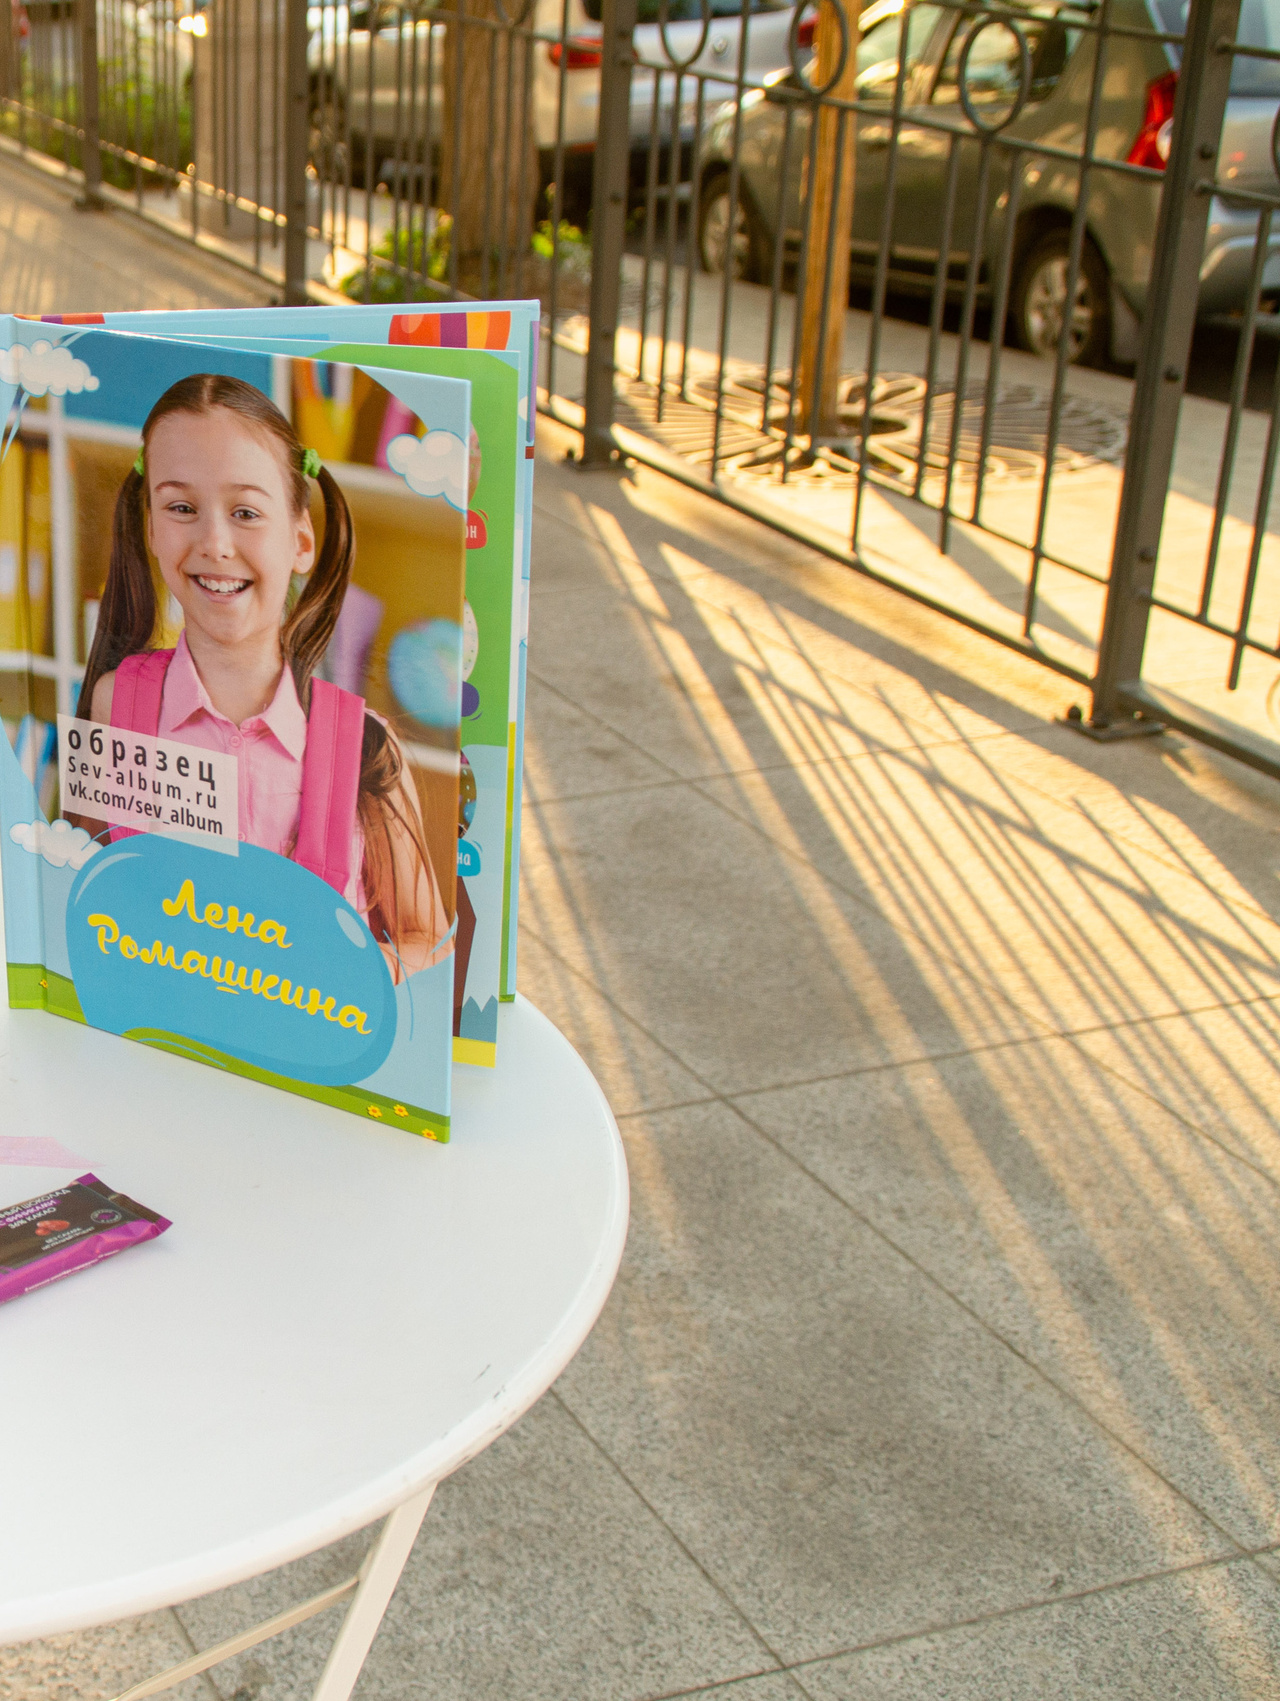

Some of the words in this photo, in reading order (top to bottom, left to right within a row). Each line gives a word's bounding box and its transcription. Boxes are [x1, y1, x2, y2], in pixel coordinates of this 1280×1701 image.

[68, 728, 216, 790] образец
[68, 755, 217, 809] Sev-album.ru
[68, 780, 223, 835] vk.com/sev_album
[162, 879, 293, 949] Лена
[87, 913, 372, 1035] Ромашкина
